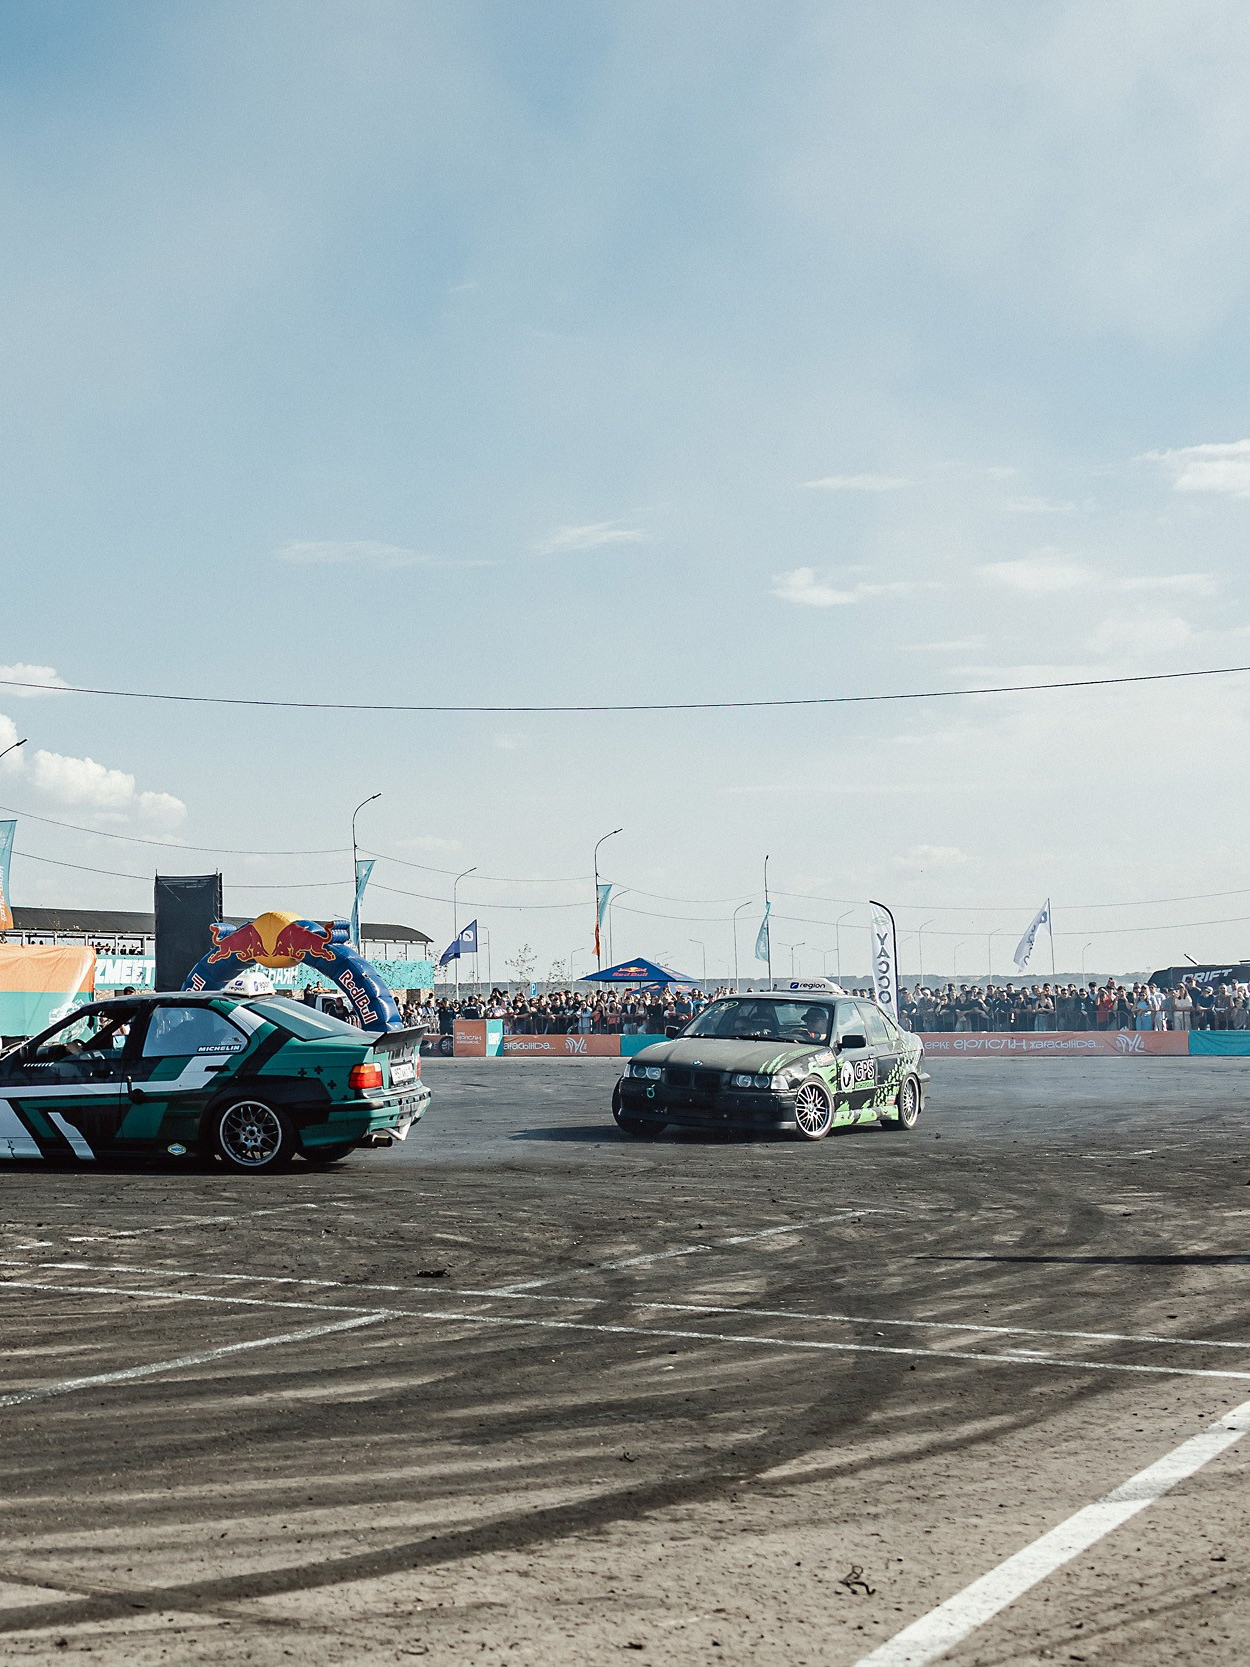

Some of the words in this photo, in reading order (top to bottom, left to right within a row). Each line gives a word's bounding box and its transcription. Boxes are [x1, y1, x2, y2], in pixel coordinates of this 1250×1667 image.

[186, 973, 207, 992] ull
[800, 982, 826, 990] region
[339, 969, 366, 1000] Red
[355, 994, 379, 1025] Bull
[854, 1059, 875, 1081] GPS
